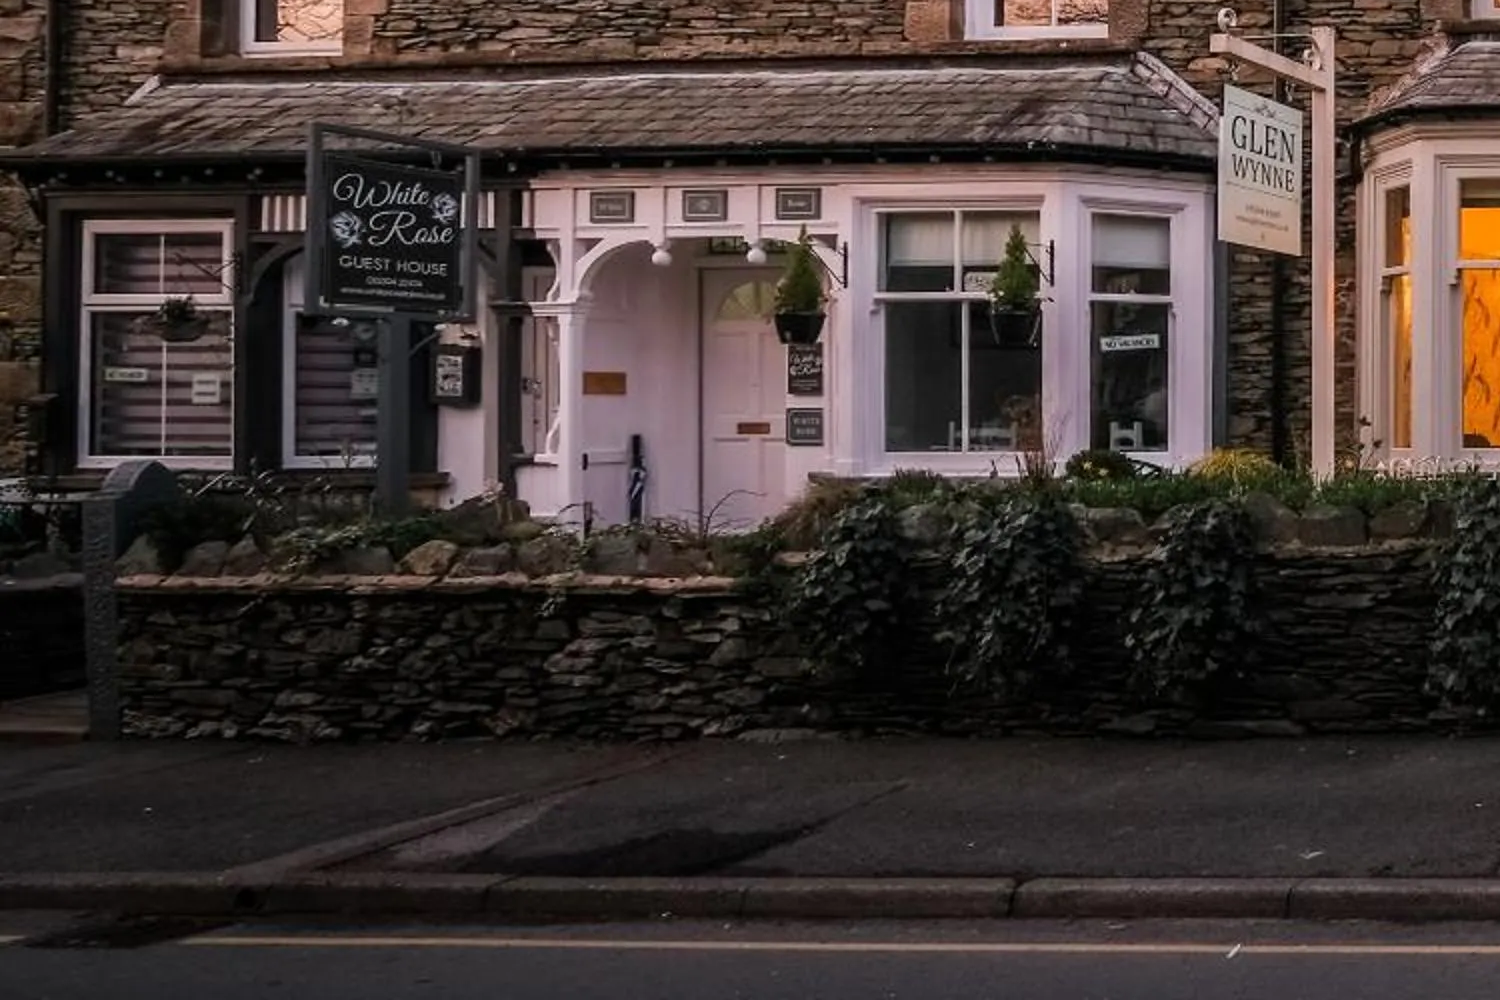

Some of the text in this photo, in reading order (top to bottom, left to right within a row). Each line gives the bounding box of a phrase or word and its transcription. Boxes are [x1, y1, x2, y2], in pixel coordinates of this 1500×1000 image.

[1231, 115, 1295, 164] GLEN
[333, 173, 430, 209] White
[1231, 153, 1295, 193] WYNNE
[368, 211, 454, 246] Rose
[339, 255, 448, 277] GUEST HOUSE
